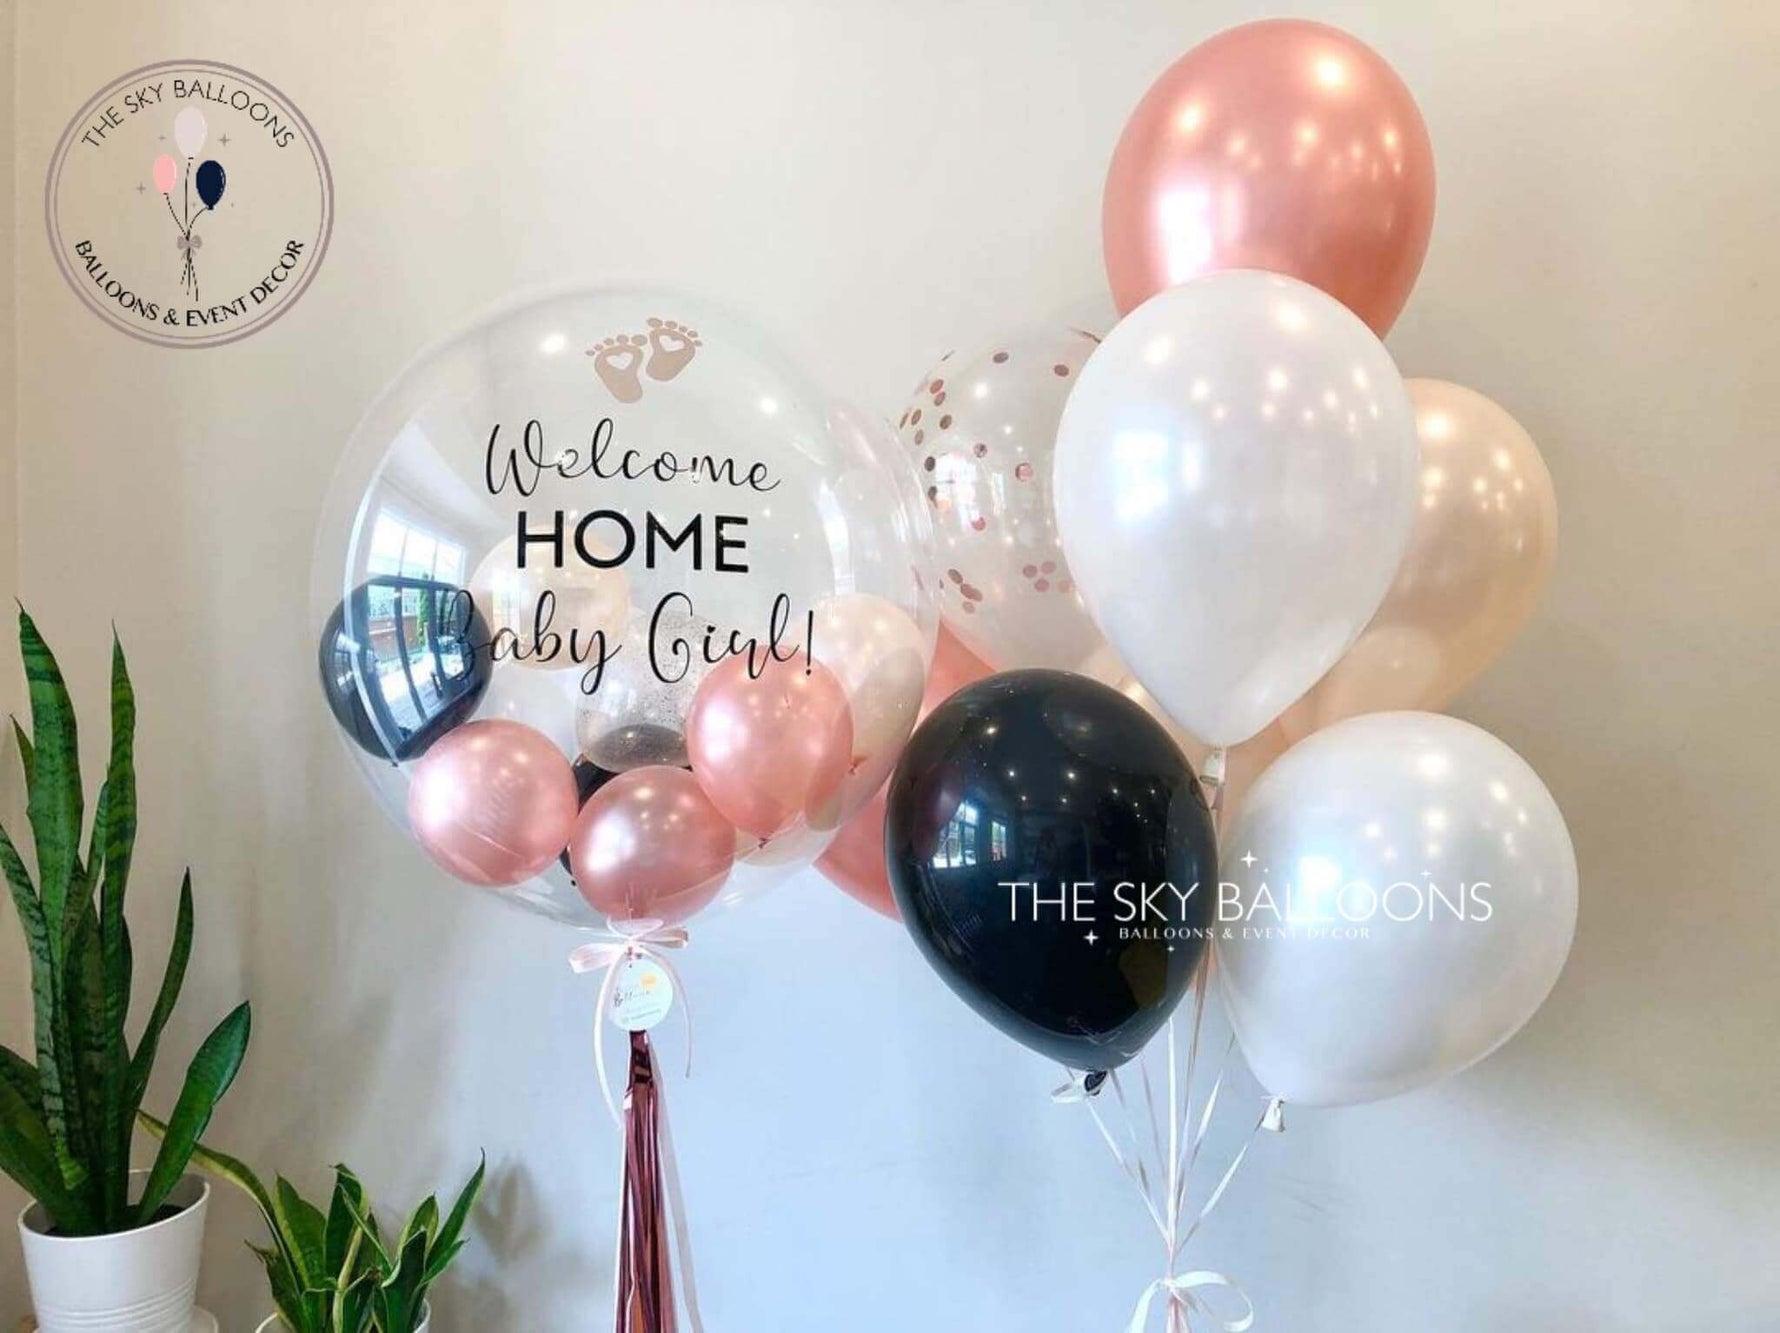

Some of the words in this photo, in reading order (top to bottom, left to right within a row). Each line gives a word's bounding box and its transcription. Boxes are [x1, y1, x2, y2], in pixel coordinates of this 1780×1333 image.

[485, 418, 782, 497] Welcome
[516, 509, 749, 573] HOME
[446, 589, 622, 695] Baby
[648, 591, 814, 684] Girl!
